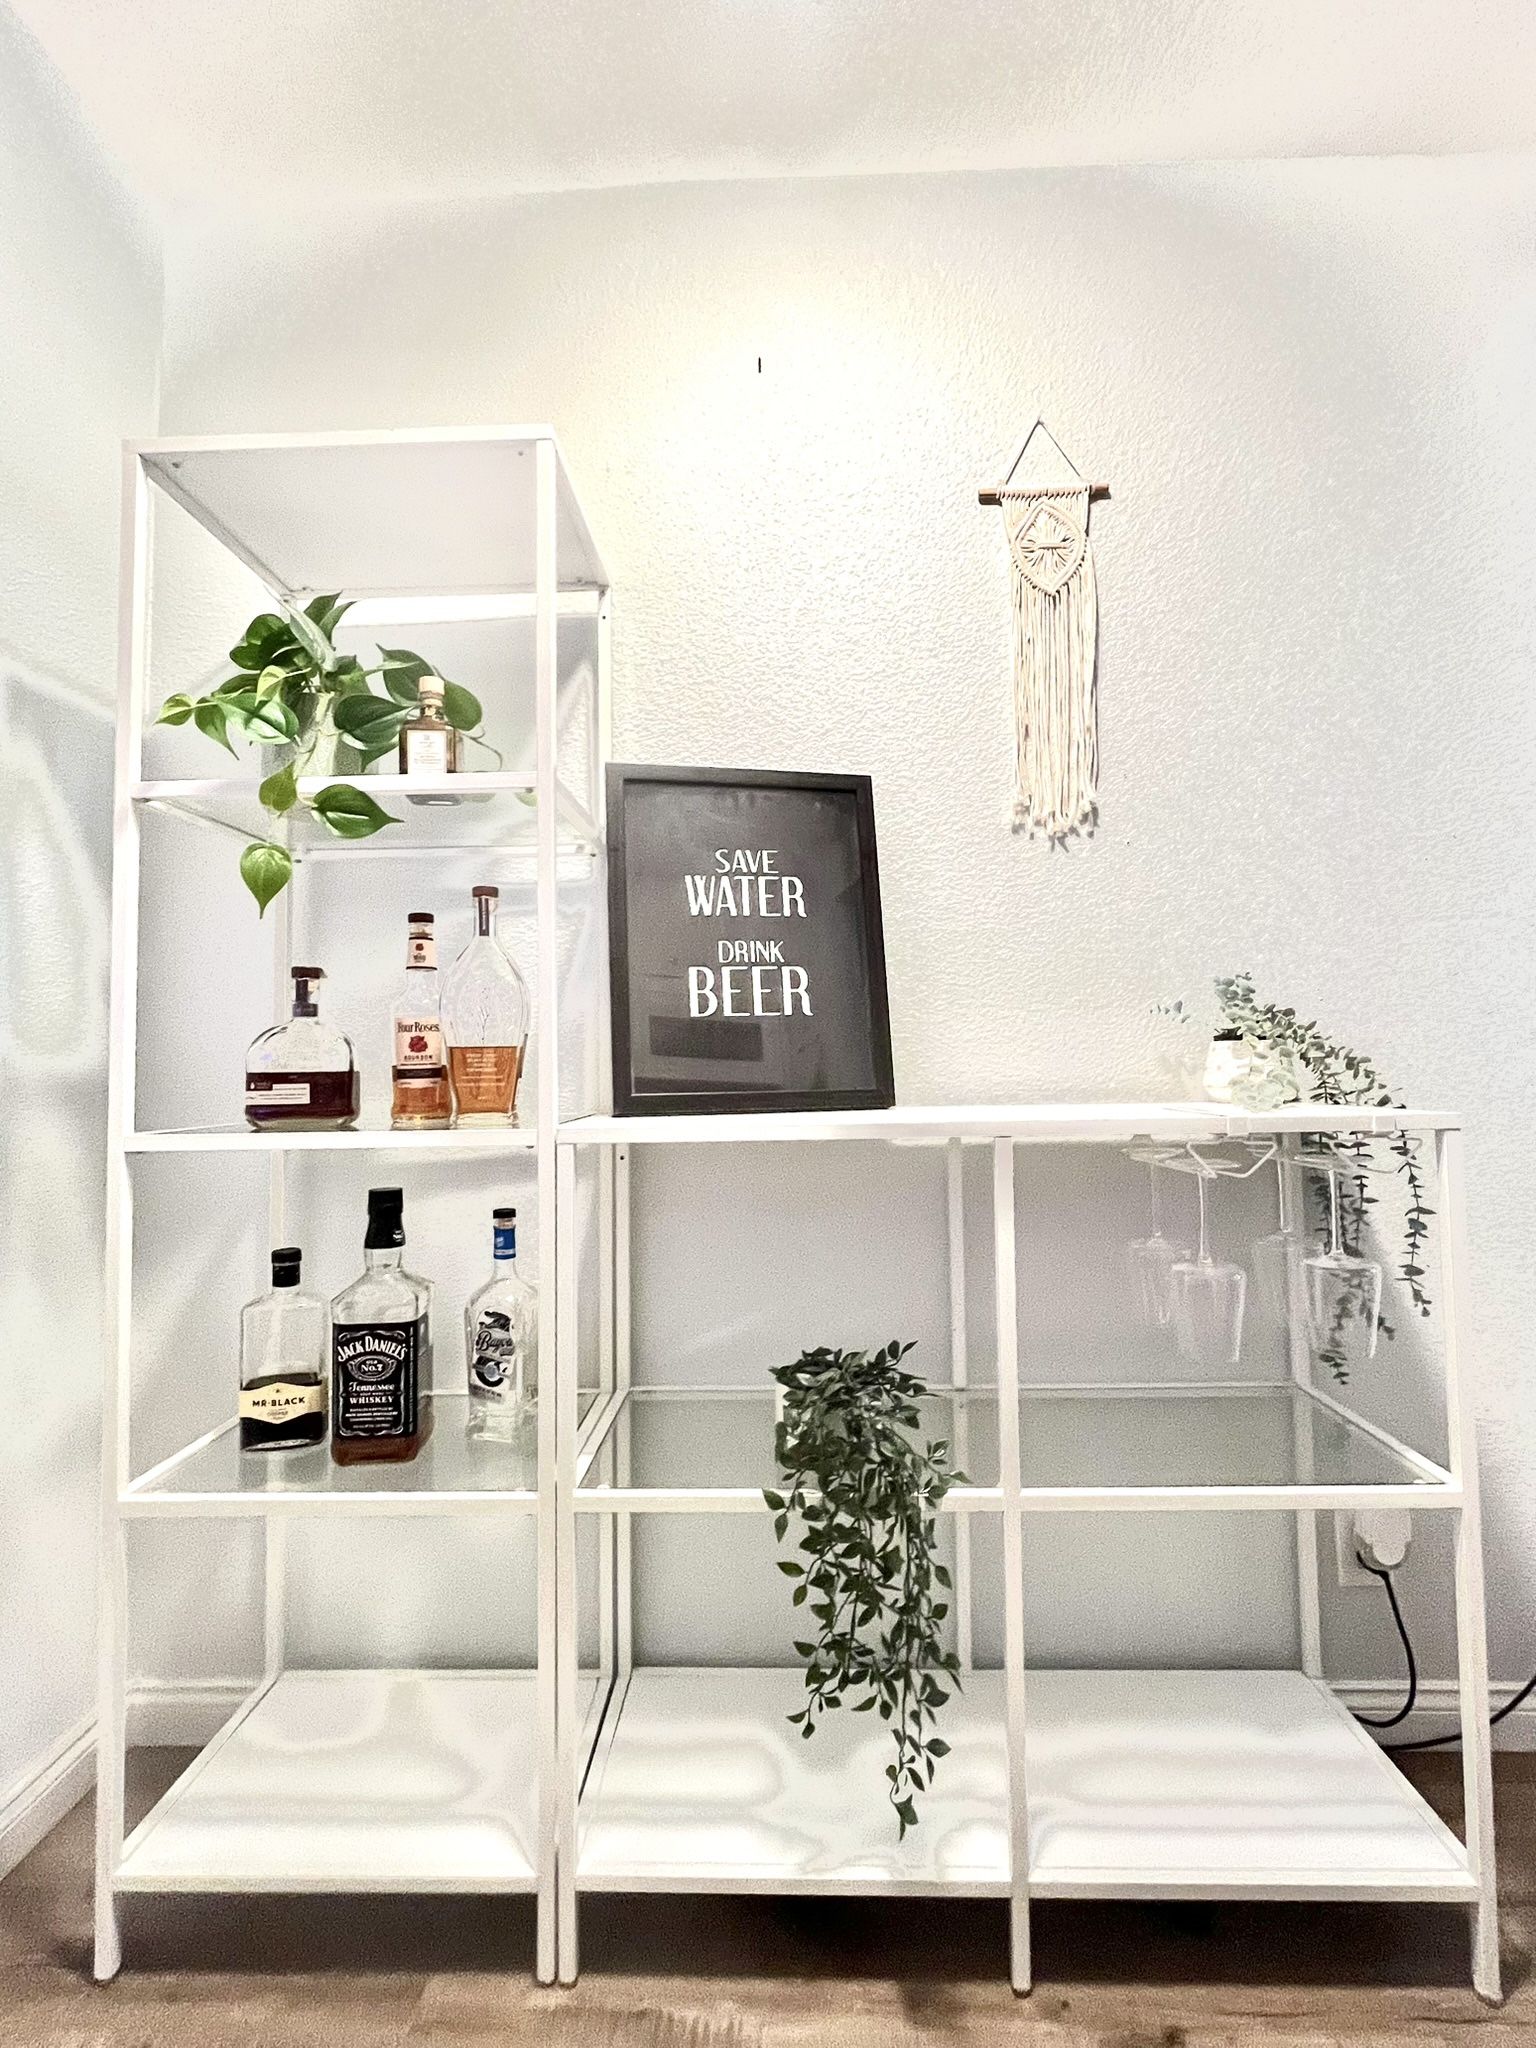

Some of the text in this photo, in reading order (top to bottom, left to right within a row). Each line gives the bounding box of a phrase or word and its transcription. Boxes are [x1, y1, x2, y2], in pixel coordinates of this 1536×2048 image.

[715, 848, 779, 874] SAVE
[684, 874, 808, 918] WATER
[717, 940, 785, 963] DRINK
[688, 965, 814, 1018] BEER
[337, 1335, 408, 1362] JACK DANIEL'S
[348, 1381, 395, 1392] Tennessee
[349, 1395, 394, 1405] WHISKEY
